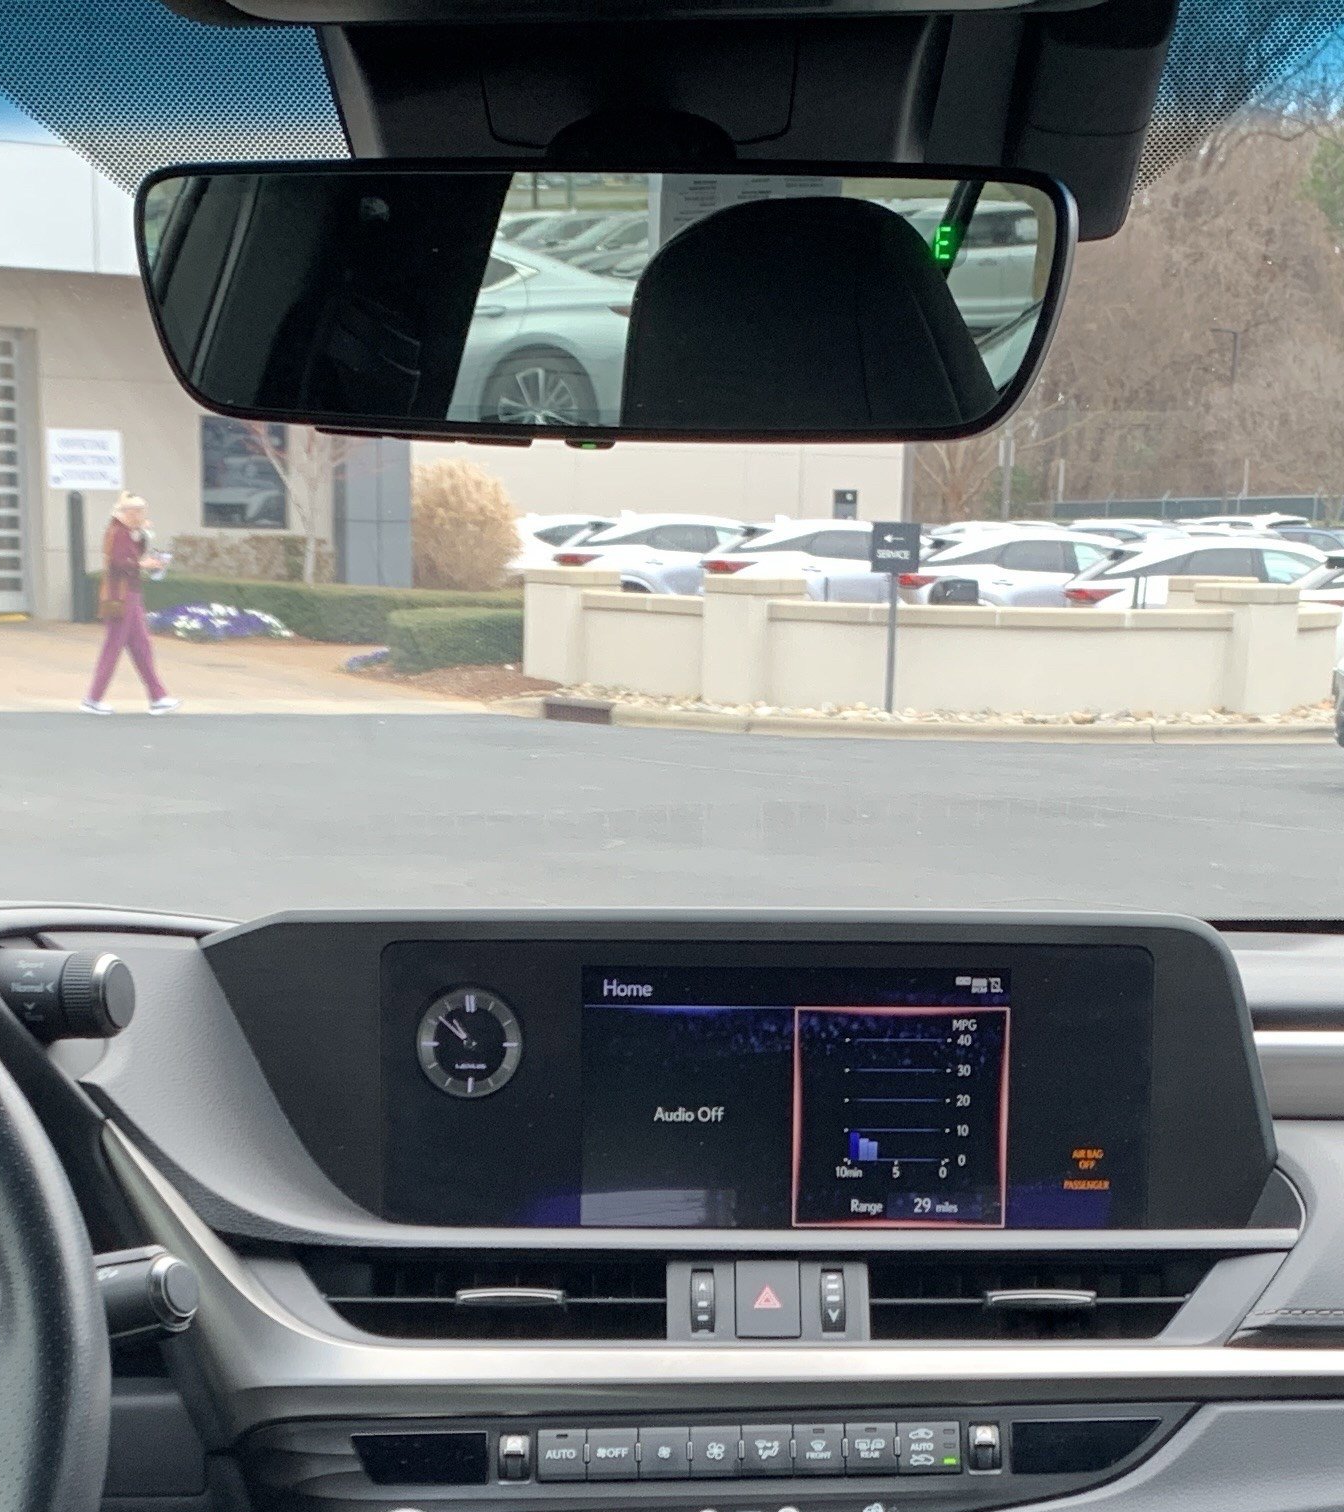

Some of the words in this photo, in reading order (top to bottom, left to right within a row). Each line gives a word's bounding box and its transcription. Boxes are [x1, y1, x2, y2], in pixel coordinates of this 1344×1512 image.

[935, 226, 952, 260] E
[603, 979, 653, 997] Home
[952, 1019, 977, 1032] MPG
[957, 1034, 972, 1047] 40
[957, 1064, 971, 1077] 30
[956, 1094, 971, 1107] 20
[653, 1106, 695, 1122] Audio
[697, 1106, 725, 1122] Off
[957, 1124, 970, 1137] 10
[958, 1154, 966, 1167] 0
[892, 1166, 900, 1179] 5
[939, 1166, 947, 1179] 0
[1063, 1180, 1110, 1190] PASSENGER
[850, 1199, 884, 1215] Range
[913, 1198, 932, 1214] 29
[935, 1202, 958, 1213] miles
[607, 1447, 629, 1458] OFF
[910, 1442, 934, 1451] AUTO
[545, 1449, 577, 1460] AUTO
[806, 1451, 832, 1459] FRONT
